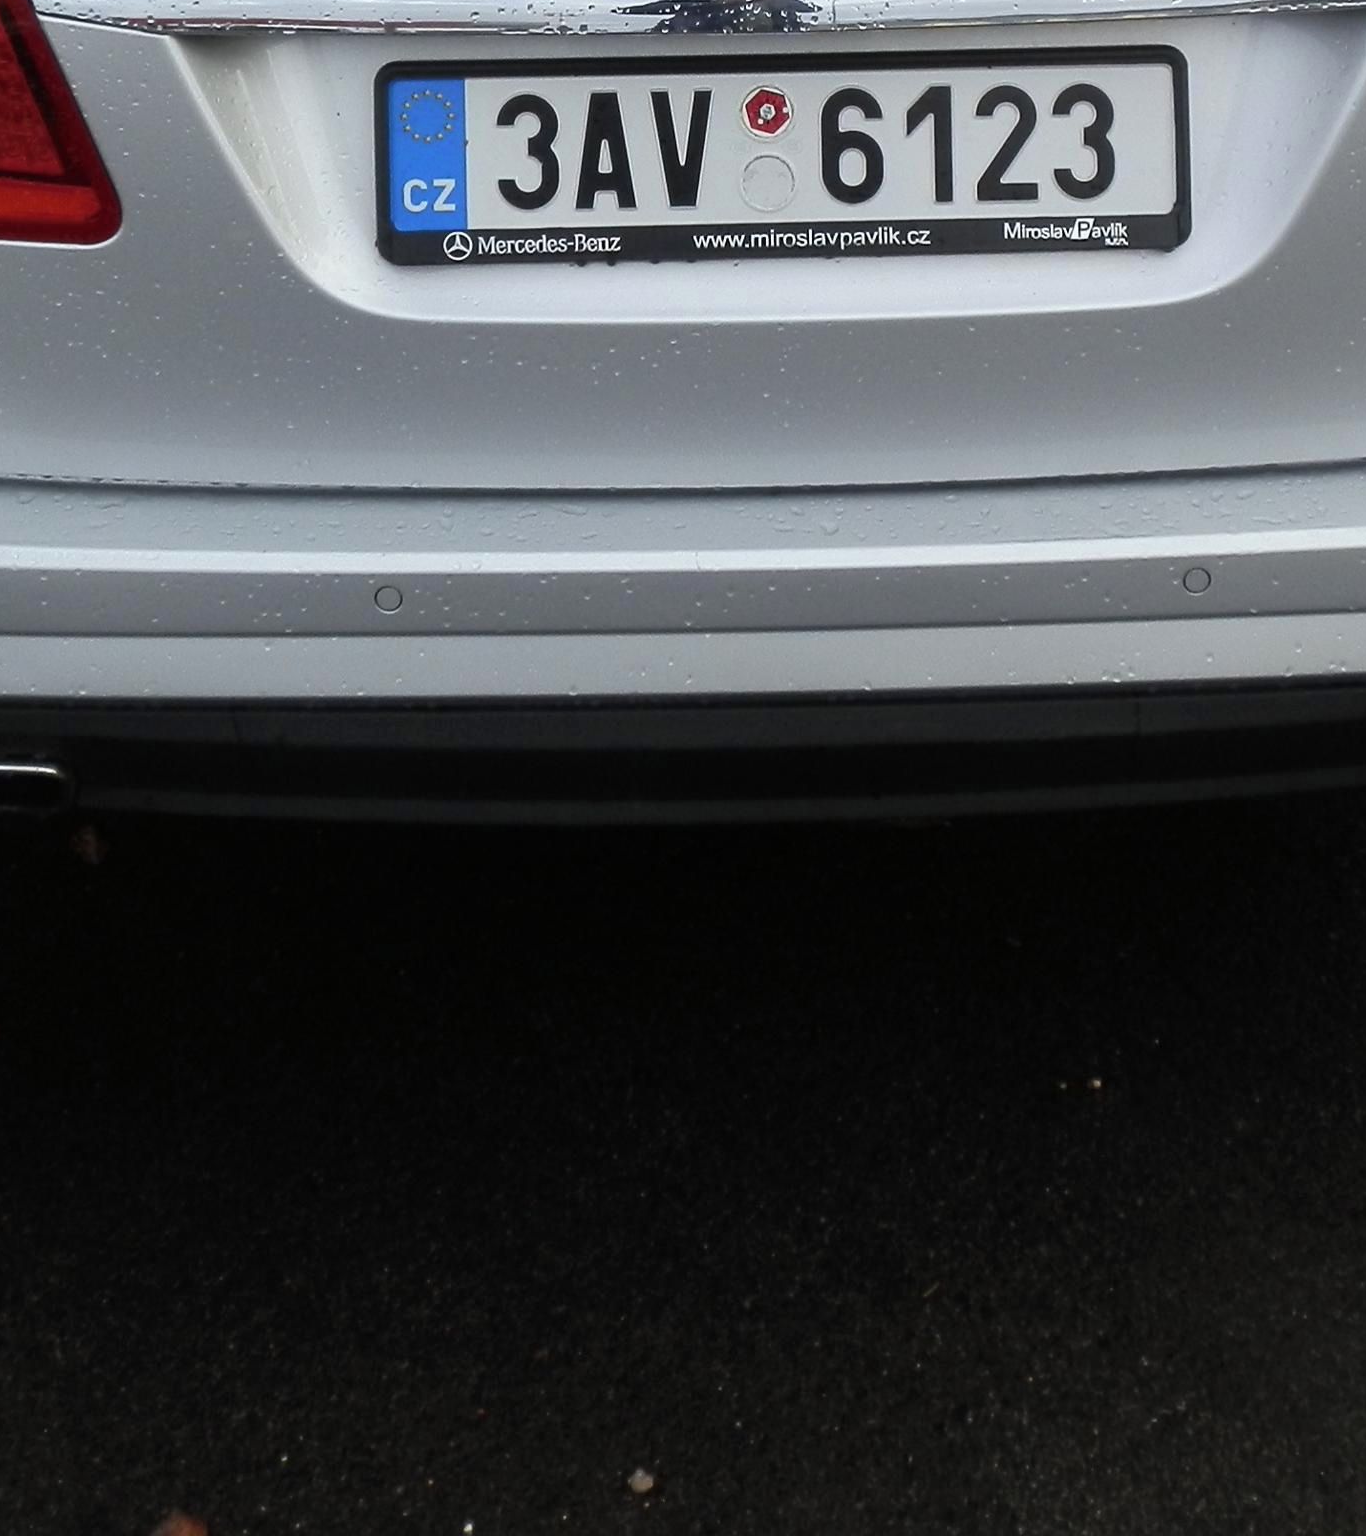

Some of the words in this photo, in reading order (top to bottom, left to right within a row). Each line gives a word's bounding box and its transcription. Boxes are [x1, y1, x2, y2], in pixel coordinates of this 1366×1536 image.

[495, 88, 713, 211] 3AV
[820, 83, 1116, 205] 6123
[402, 177, 457, 213] CZ
[477, 233, 622, 256] Mercedes-Benz
[692, 226, 932, 251] www.miroslavpavlik.cz
